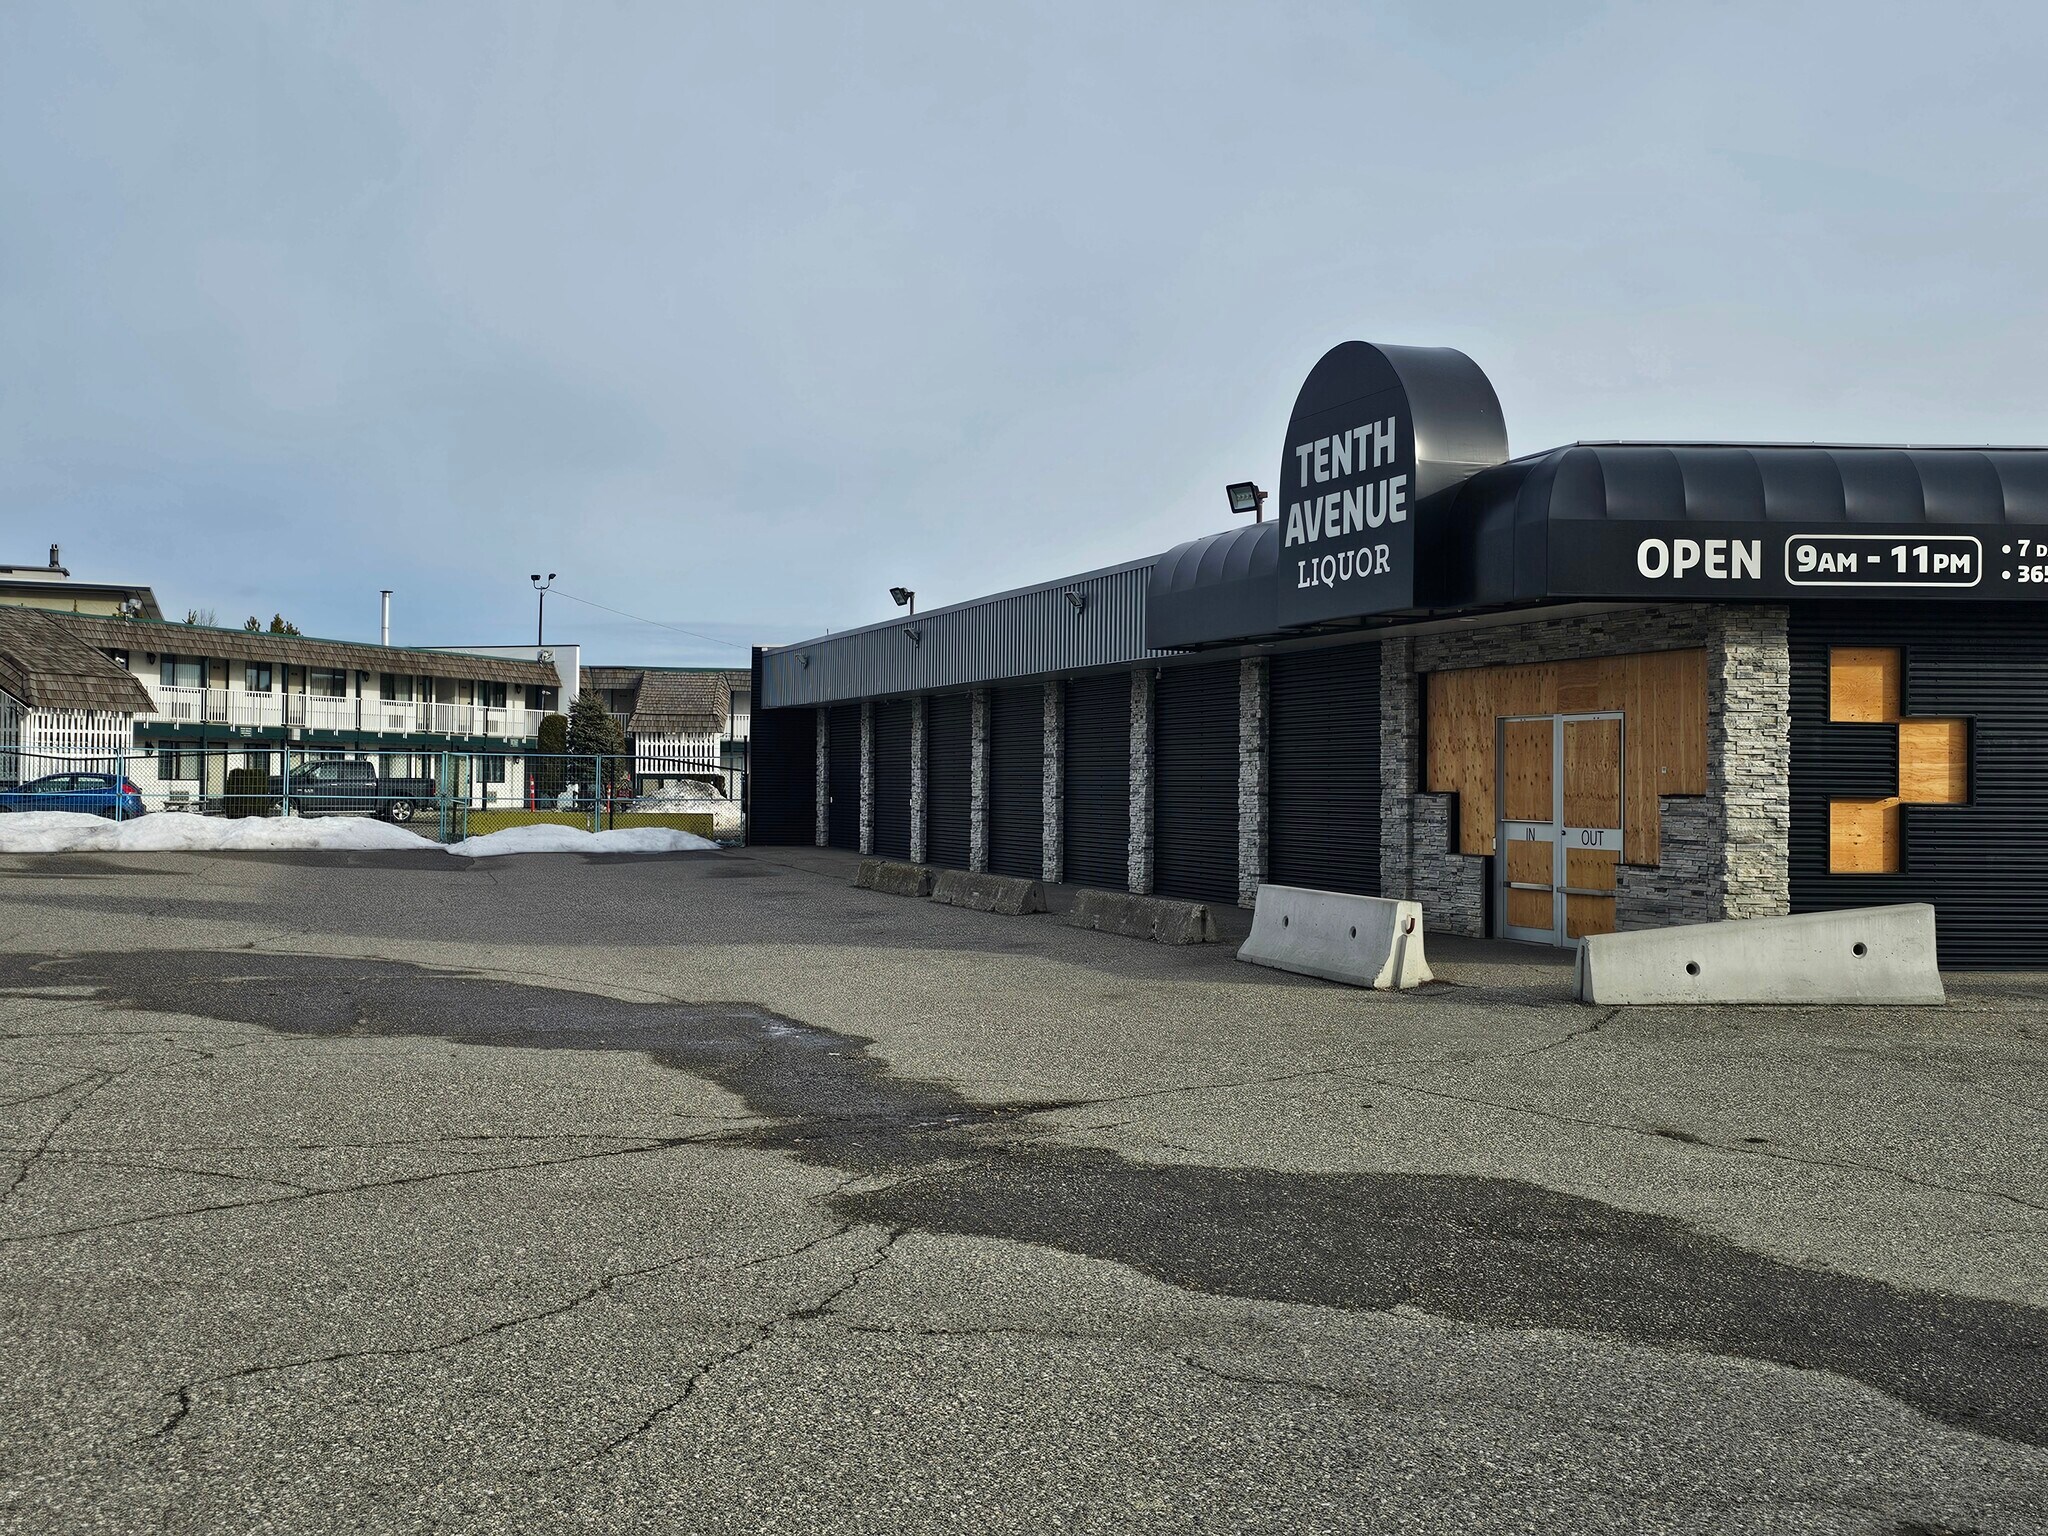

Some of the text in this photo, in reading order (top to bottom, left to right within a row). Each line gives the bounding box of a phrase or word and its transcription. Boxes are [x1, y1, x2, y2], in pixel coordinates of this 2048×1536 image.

[1296, 416, 1396, 488] TENTH
[1285, 474, 1407, 548] AVENUE
[1297, 544, 1391, 589] LIQUOR
[1637, 538, 1761, 579] OPEN
[1796, 544, 1858, 573] 9AM
[1891, 545, 1971, 574] 11PM
[2017, 539, 2048, 557] 7 D
[1526, 827, 1536, 842] IN
[1581, 829, 1605, 846] OUT
